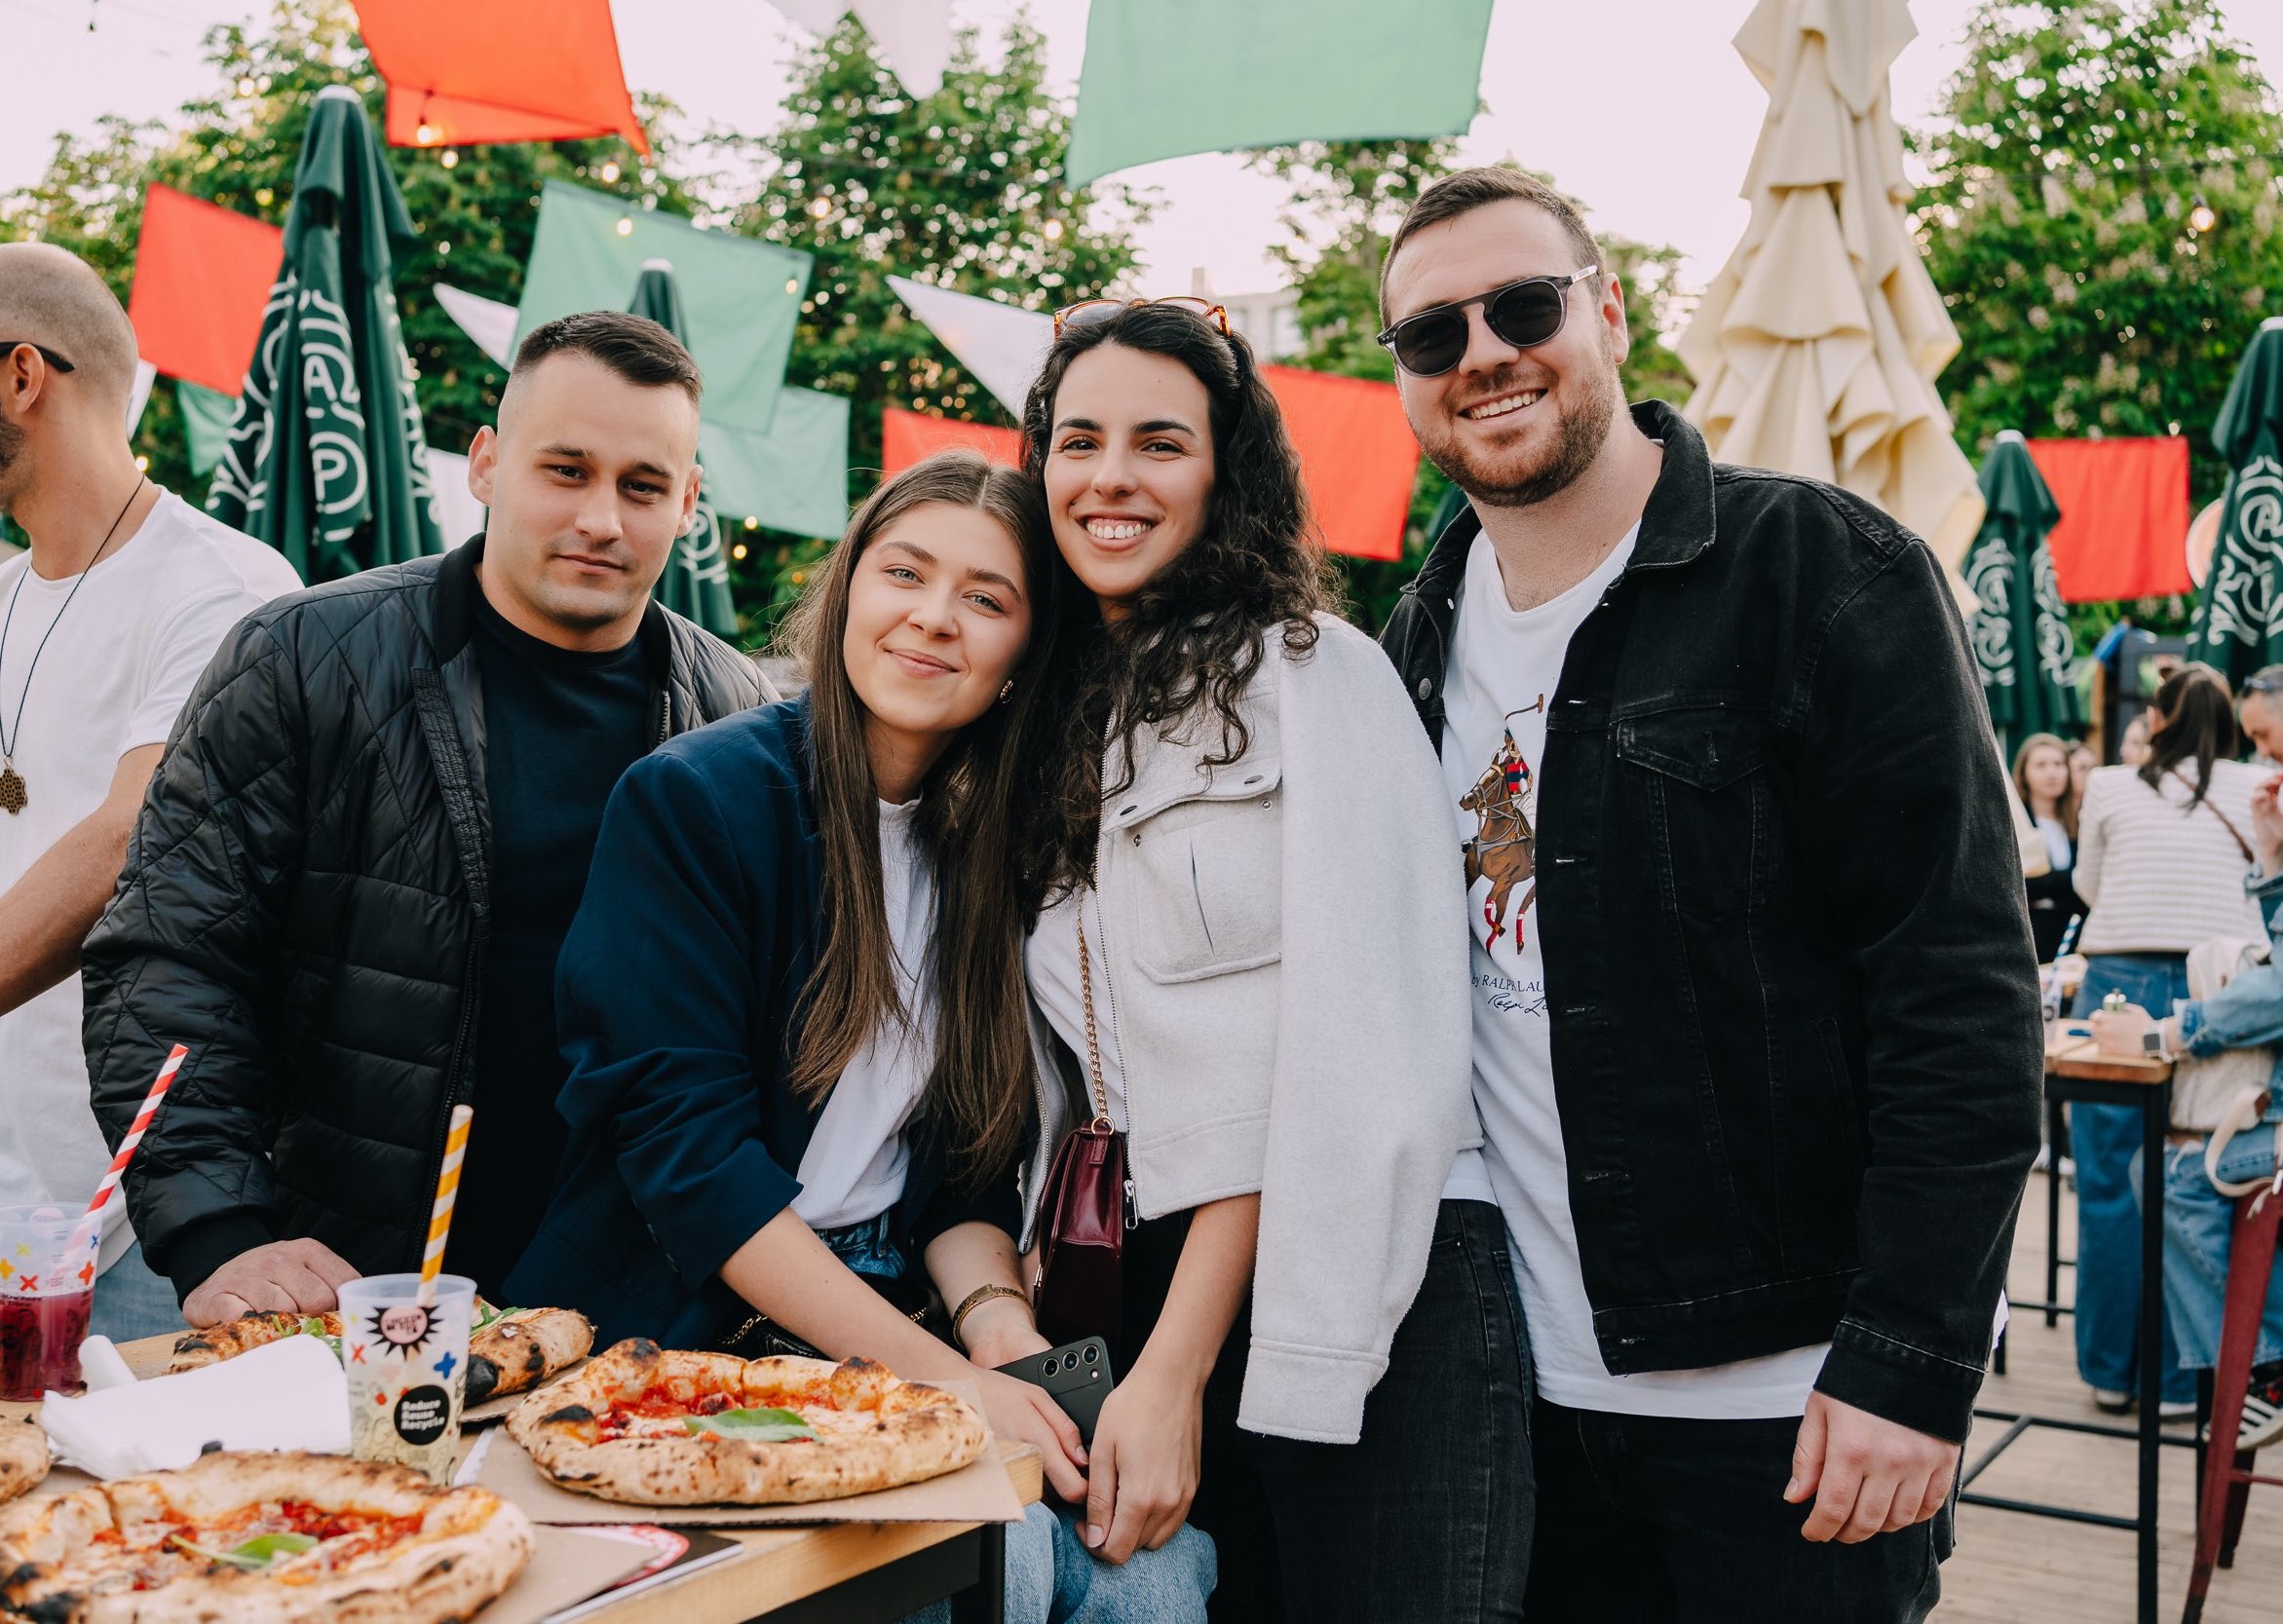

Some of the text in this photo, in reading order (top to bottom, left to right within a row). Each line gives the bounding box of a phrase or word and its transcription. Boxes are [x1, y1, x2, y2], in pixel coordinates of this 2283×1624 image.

[400, 1399, 441, 1412] Reduce
[400, 1410, 436, 1421] Reuse
[400, 1416, 445, 1431] Recycle
